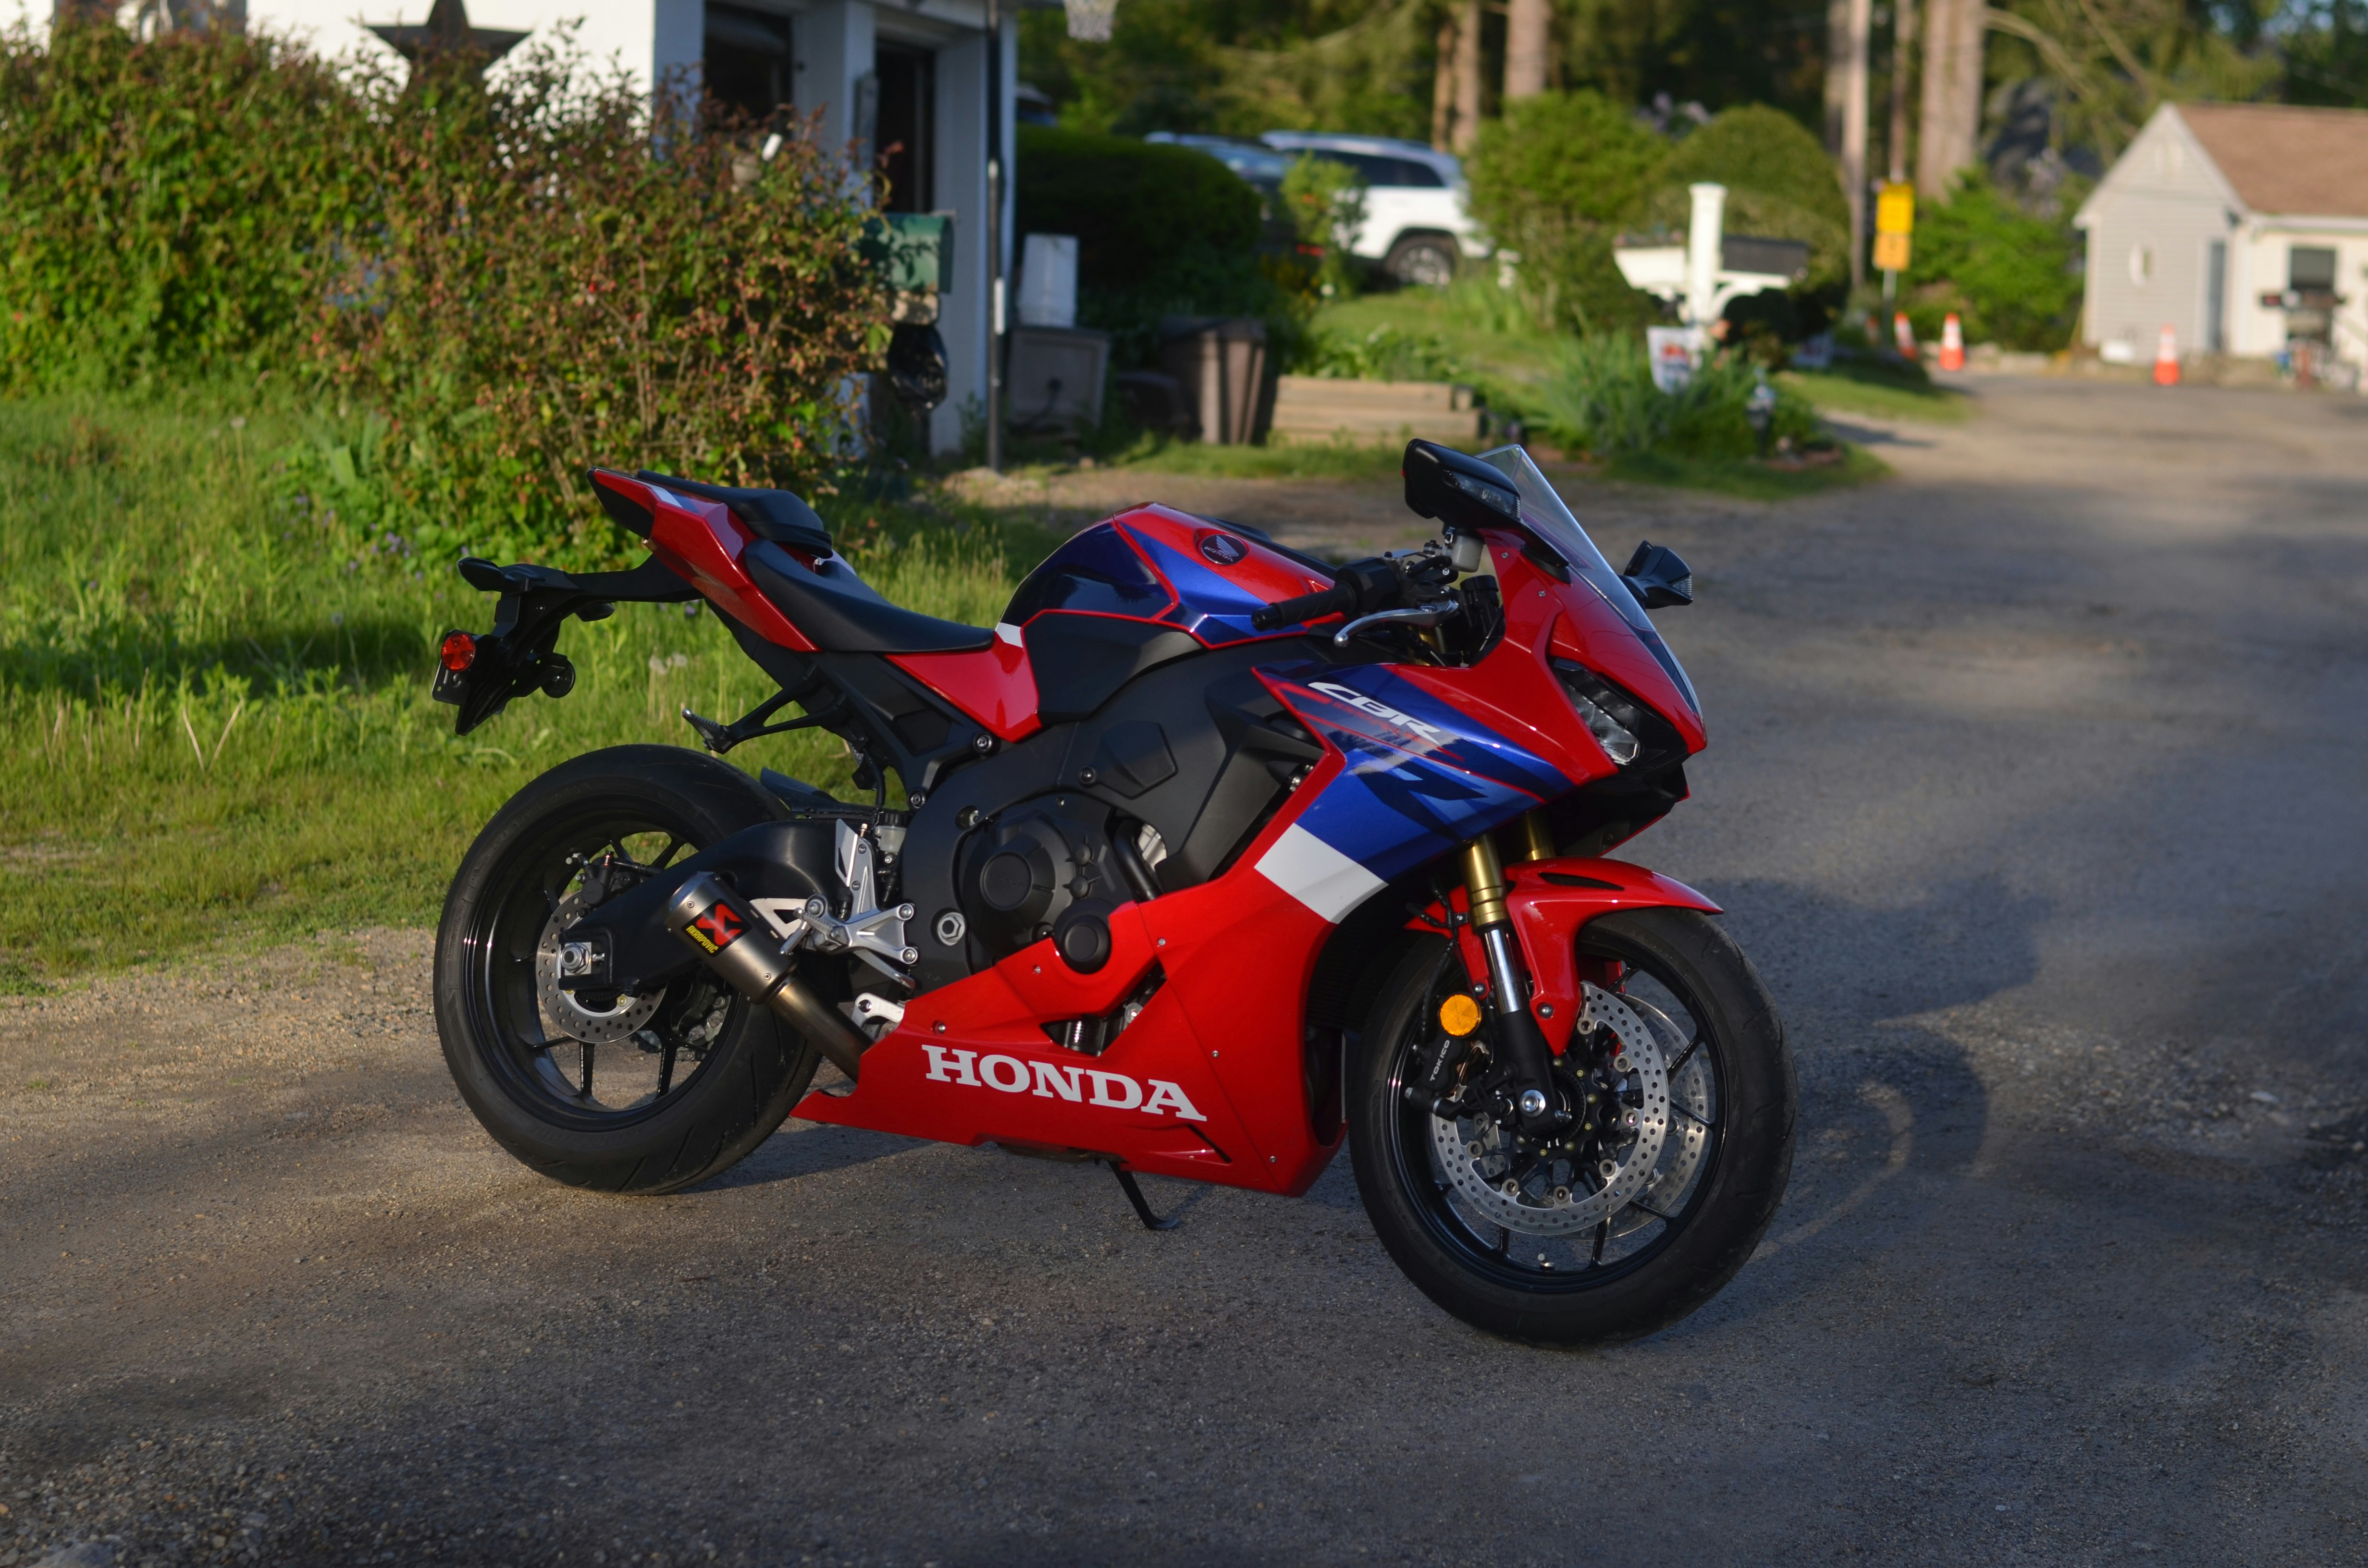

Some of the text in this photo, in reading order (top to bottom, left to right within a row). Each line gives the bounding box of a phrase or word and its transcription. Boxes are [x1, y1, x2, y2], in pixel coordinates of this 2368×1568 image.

[1204, 546, 1234, 562] HONDA
[1307, 682, 1442, 746] CBR
[921, 1044, 1207, 1122] HONDA
[1429, 1039, 1451, 1081] TOKICO
